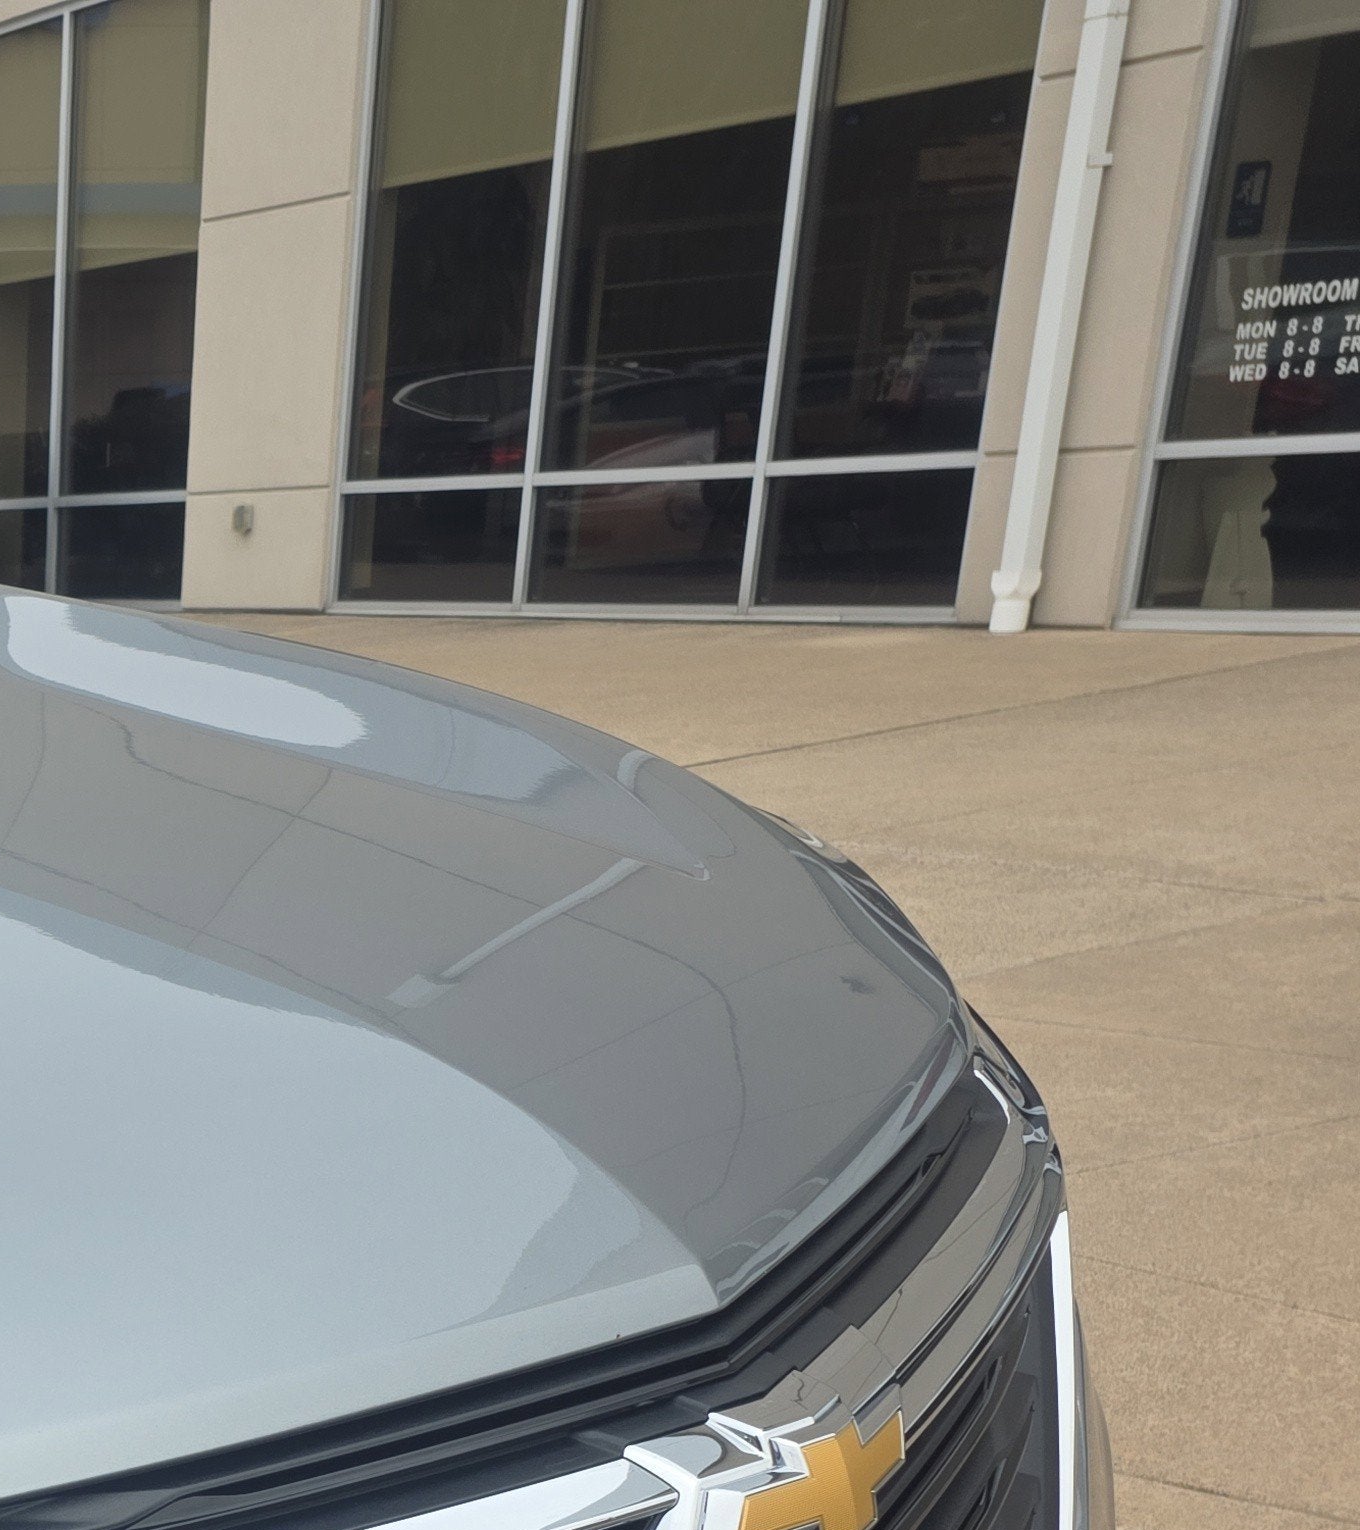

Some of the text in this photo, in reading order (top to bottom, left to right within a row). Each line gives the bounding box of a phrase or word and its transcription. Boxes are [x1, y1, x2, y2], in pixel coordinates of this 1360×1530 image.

[1241, 278, 1359, 310] SHOWROOM
[1236, 320, 1277, 340] MON
[1233, 341, 1269, 361] TUE
[1229, 363, 1267, 382] WED
